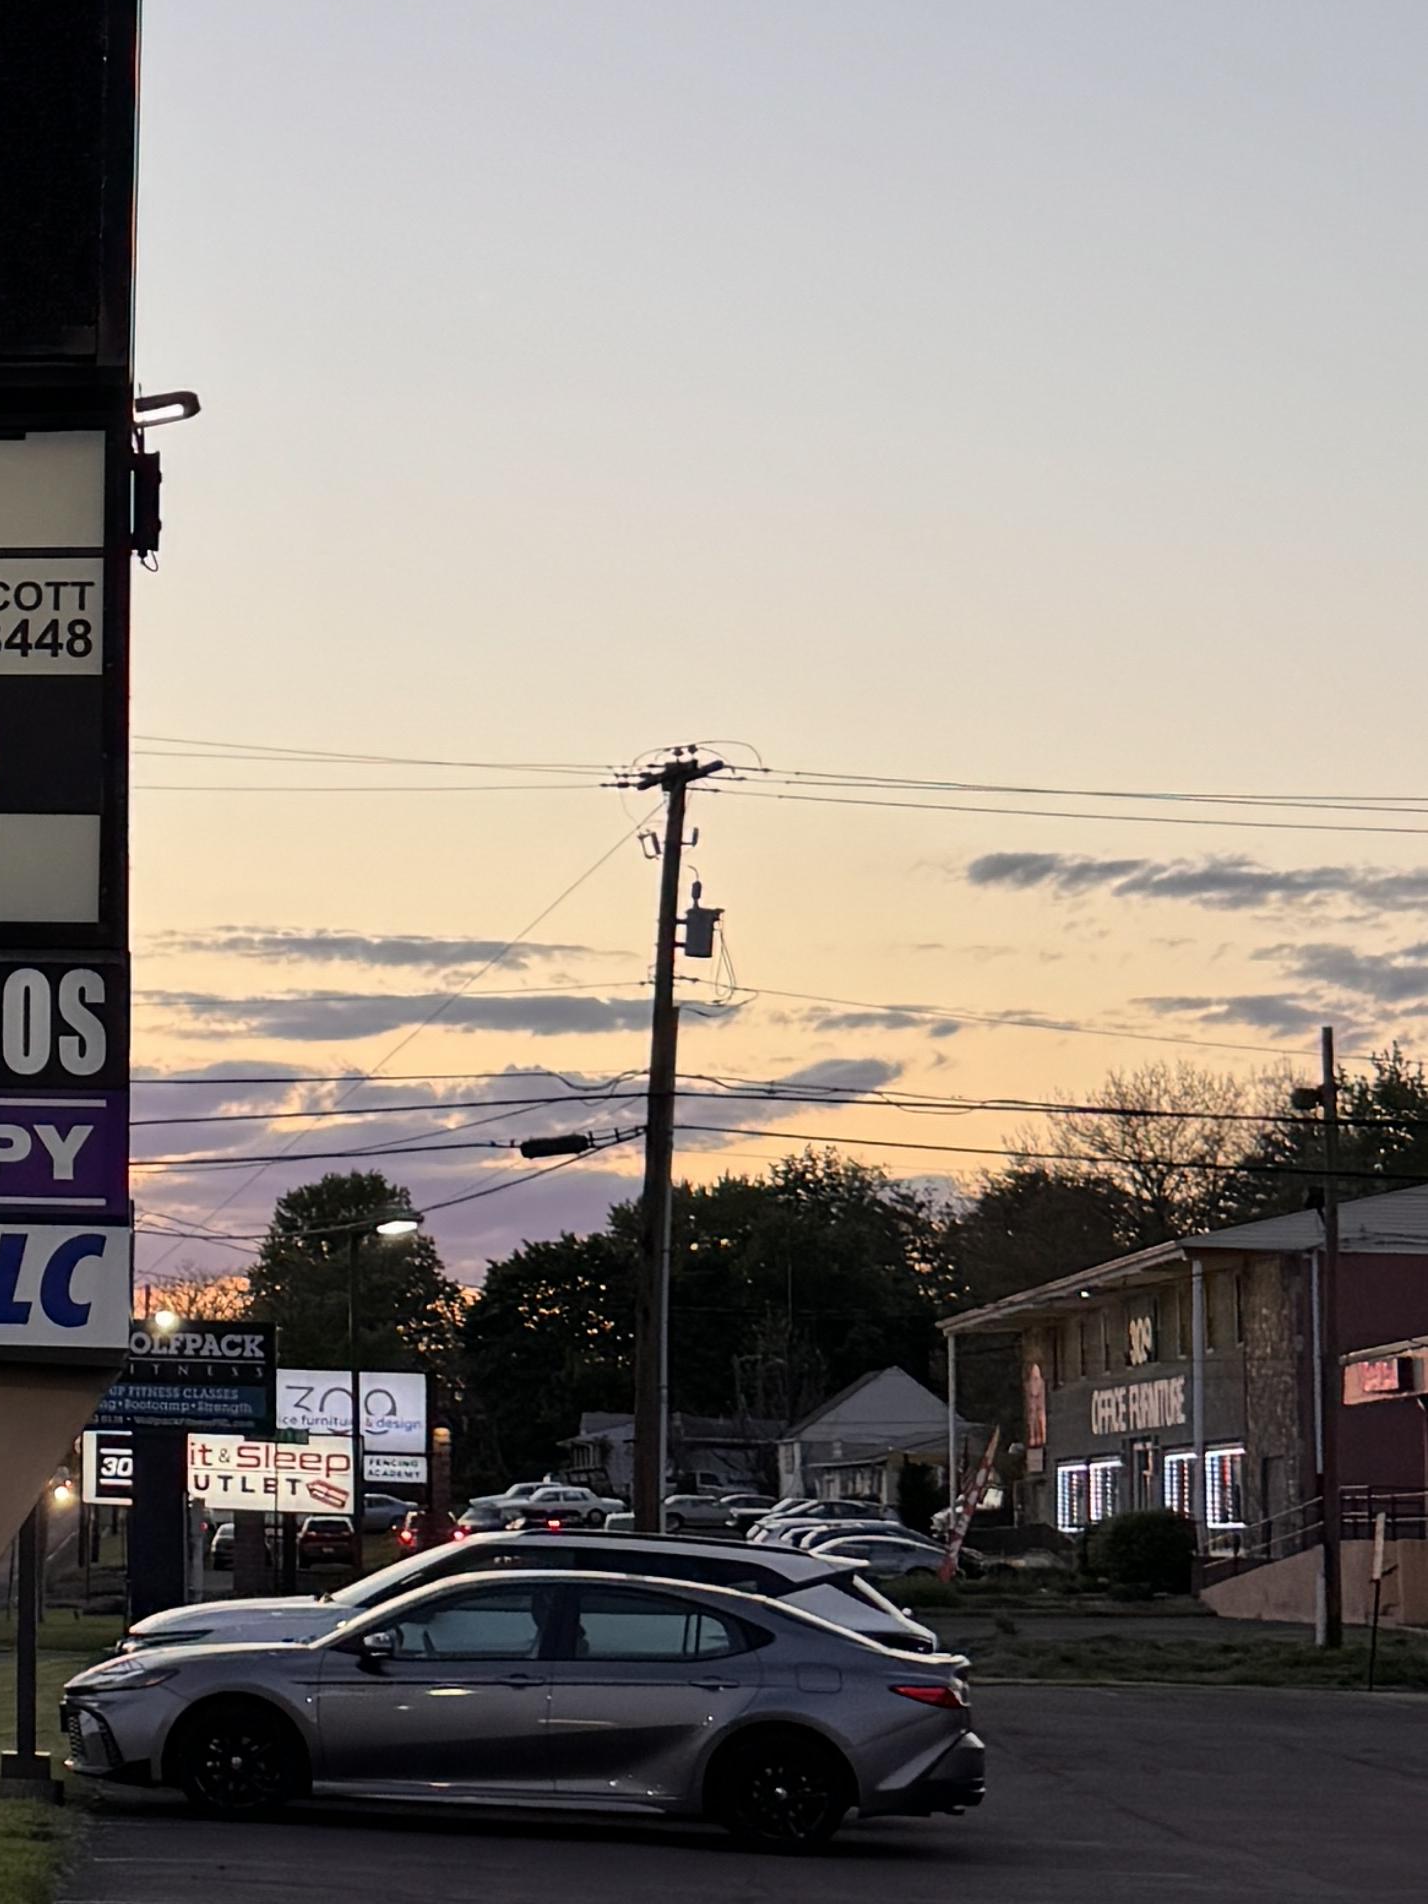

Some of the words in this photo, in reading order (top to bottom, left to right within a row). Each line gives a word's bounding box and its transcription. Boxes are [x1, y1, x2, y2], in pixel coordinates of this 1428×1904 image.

[129, 1331, 266, 1359] OLFPACK
[128, 1364, 264, 1378] ITNESS
[128, 1385, 181, 1400] FITNESS
[182, 1386, 240, 1401] CLASSES
[123, 1399, 190, 1414] Bootcamp
[1090, 1384, 1127, 1436] OFFICE
[1128, 1374, 1187, 1432] FURNITURE
[300, 1414, 353, 1427] furnitu
[375, 1417, 421, 1432] design
[189, 1442, 214, 1466] it
[218, 1448, 231, 1464] &
[236, 1444, 351, 1479] Sleep
[368, 1458, 419, 1468] FENCING
[367, 1468, 421, 1479] ACADEMY
[193, 1474, 302, 1495] UTLET
